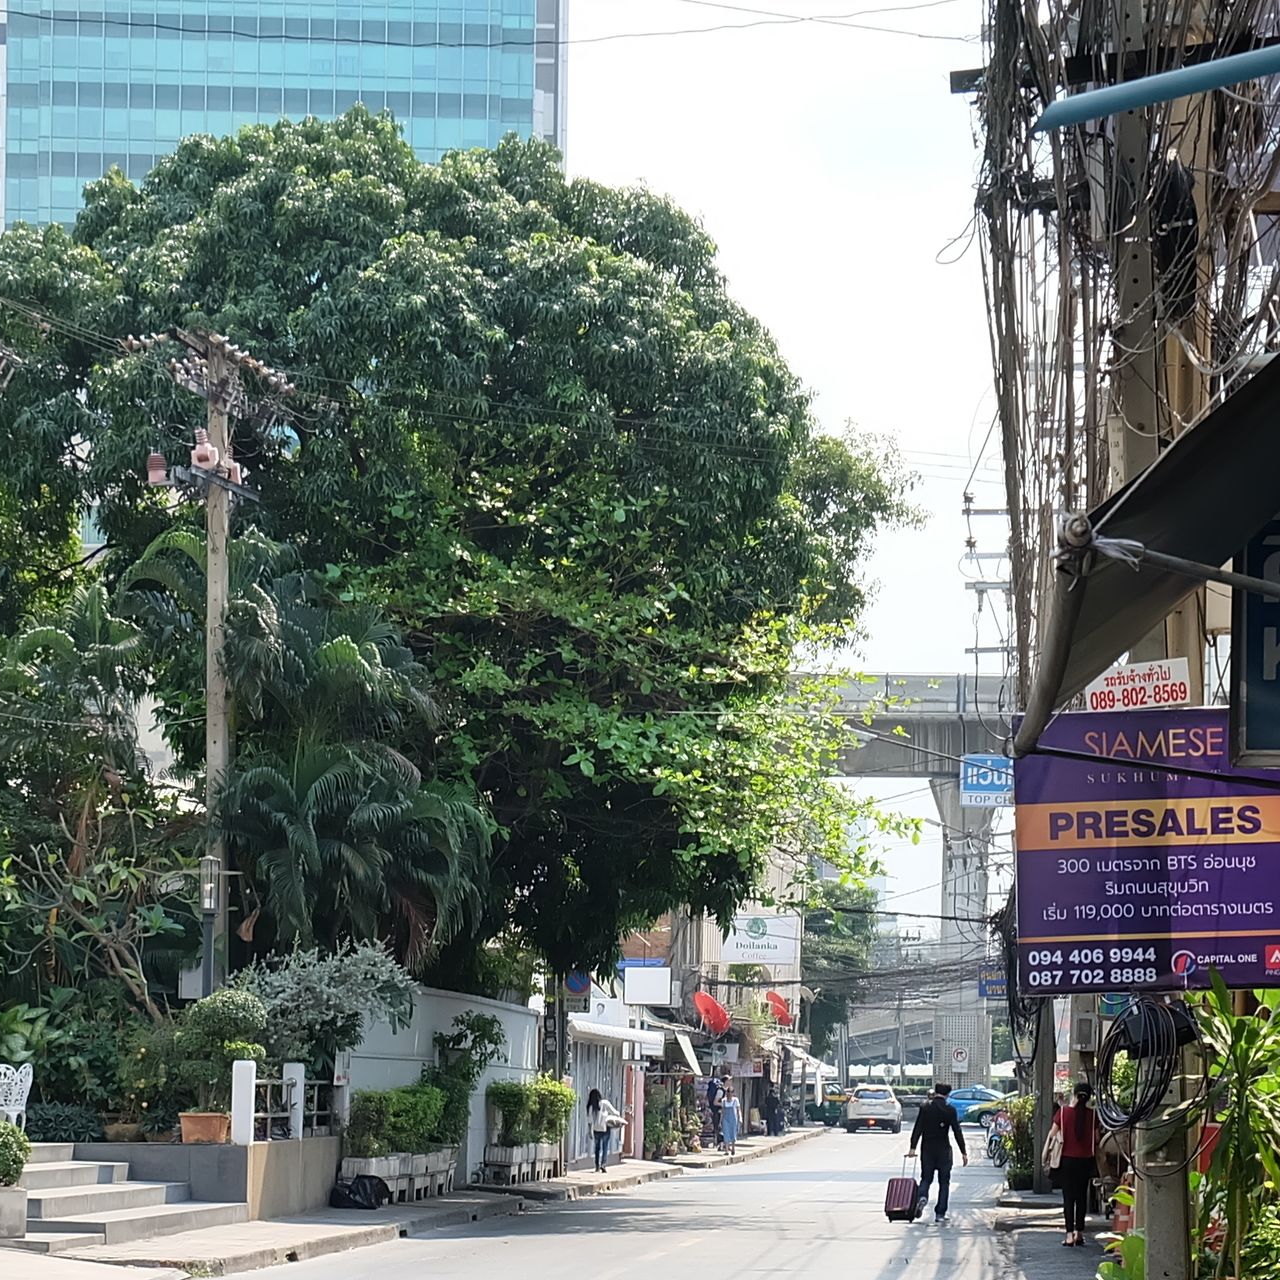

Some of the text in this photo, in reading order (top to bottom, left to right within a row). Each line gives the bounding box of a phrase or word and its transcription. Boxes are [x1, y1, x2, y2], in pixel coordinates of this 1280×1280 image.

[1104, 664, 1171, 687] รถรับจ้างทั่วไป
[1090, 681, 1187, 710] 089-802-8569
[1084, 728, 1223, 758] SIAMESE
[968, 795, 1011, 805] TOP CH
[1049, 805, 1262, 841] PRESALES
[1057, 853, 1256, 874] 300 เมตรจาก BTS อ่อนนุช
[1105, 879, 1209, 897] ริมถนนสุขุมวิท
[1043, 901, 1274, 921] เริ่ม 119,000 บาทต่อตารางเมตร
[736, 941, 778, 950] Doilanka
[741, 951, 767, 960] Coffee
[1028, 947, 1157, 966] 094 406 9944
[1197, 953, 1258, 964] CAPITAL ONE
[1028, 968, 1157, 986] 087 702 8888
